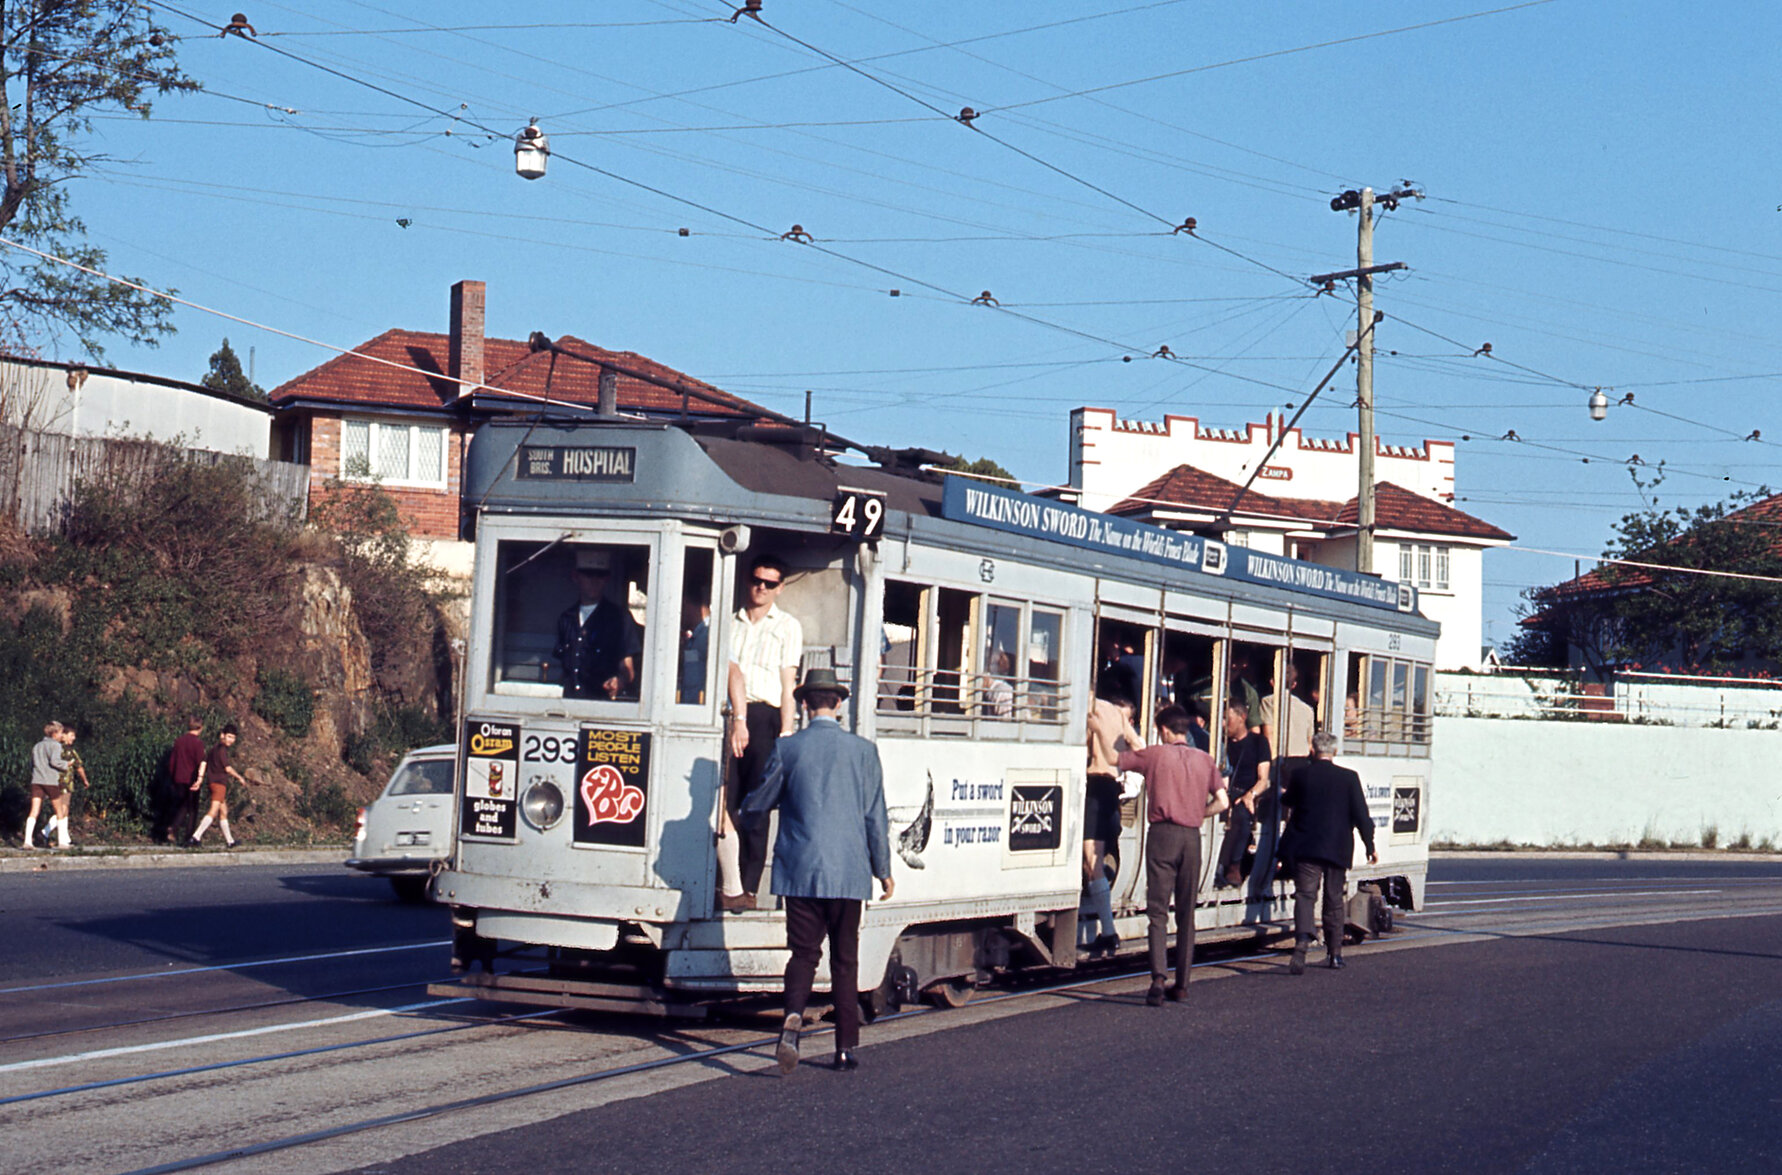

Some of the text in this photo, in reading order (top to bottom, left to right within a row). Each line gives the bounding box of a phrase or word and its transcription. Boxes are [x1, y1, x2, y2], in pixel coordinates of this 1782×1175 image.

[528, 449, 554, 461] SOUTH
[563, 449, 632, 475] HOSPITAL
[530, 461, 552, 475] BRIS.
[965, 488, 1039, 529] WILKINSON
[1041, 507, 1088, 540] SWORD
[1088, 518, 1103, 542] The
[1102, 521, 1123, 547] Name
[1122, 533, 1132, 549] on
[1131, 529, 1142, 551] the
[1247, 554, 1295, 585] WILKINSON
[1295, 565, 1324, 590] SWORD
[481, 723, 512, 737] O for an
[588, 730, 642, 742] MOST
[471, 733, 514, 752] Osram
[524, 735, 579, 764] 293
[588, 740, 641, 754] PEOPLE
[587, 752, 640, 764] LISTEN
[620, 765, 640, 775] TO
[952, 779, 1004, 801] Put a sword
[473, 798, 506, 813] globes
[1012, 800, 1054, 815] WILKINSON
[479, 812, 499, 823] and
[475, 822, 503, 835] tubes
[944, 822, 1002, 848] in your razor
[1020, 822, 1042, 834] SWORD
